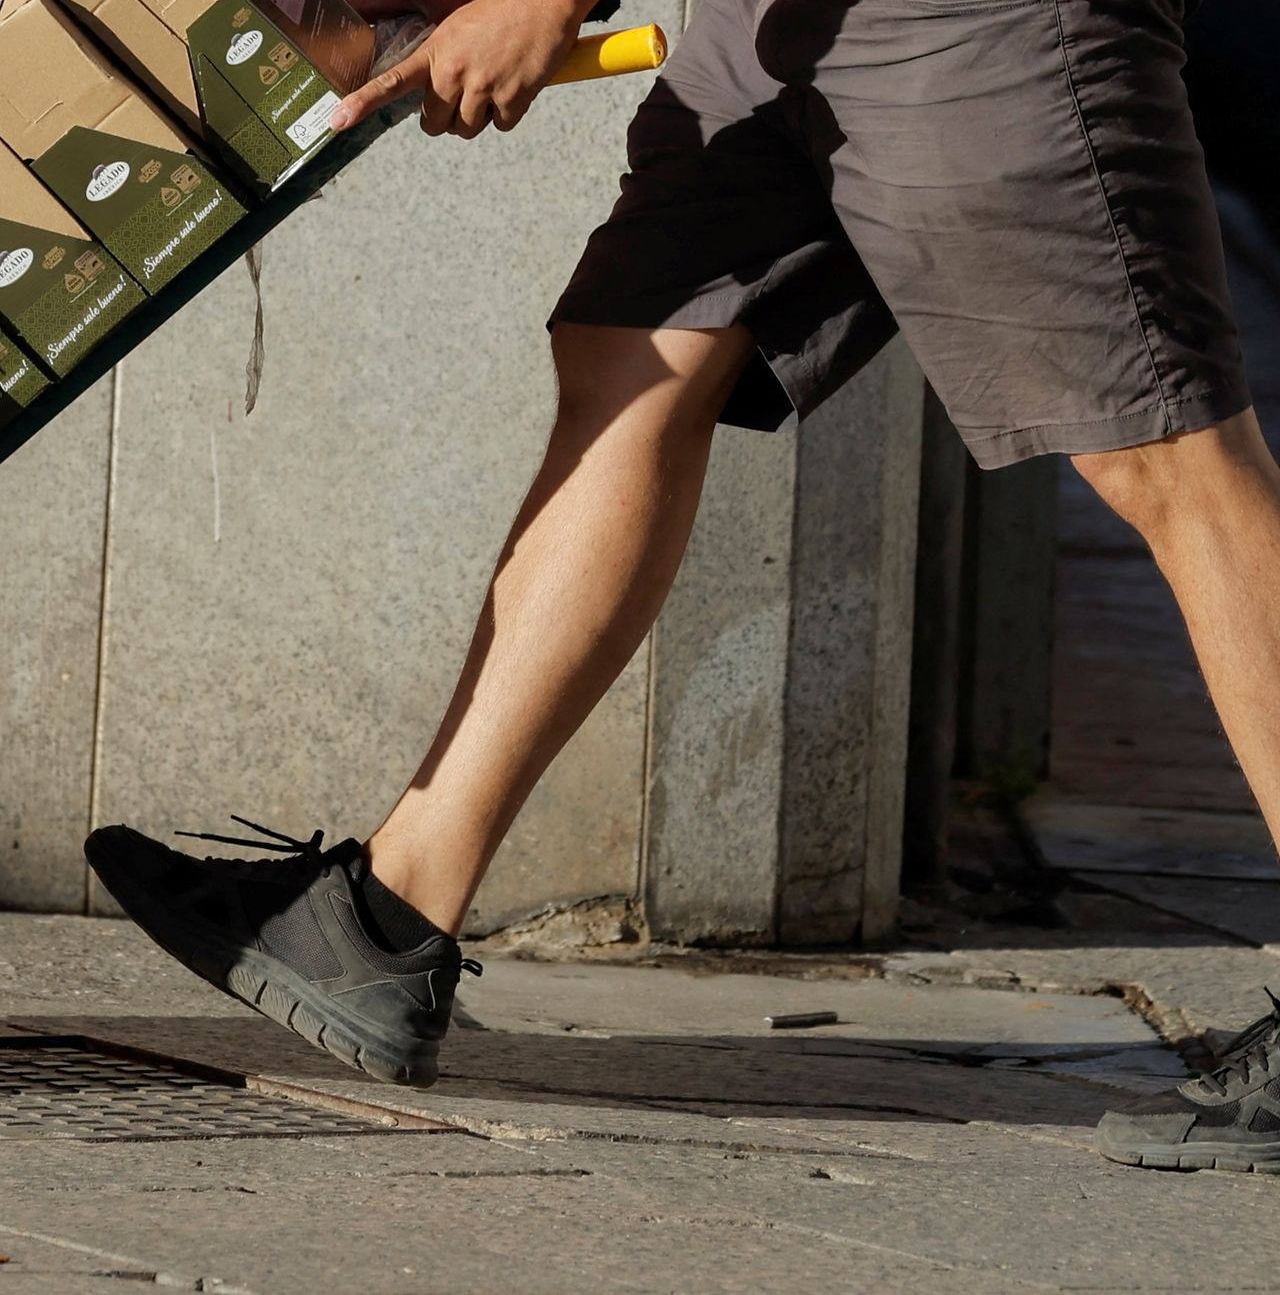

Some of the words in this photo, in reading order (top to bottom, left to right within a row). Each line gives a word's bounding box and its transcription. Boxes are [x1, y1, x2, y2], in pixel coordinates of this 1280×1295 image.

[227, 32, 259, 62] LEGADO
[88, 164, 125, 197] LEGADO
[142, 236, 180, 279] ¡Siempre
[179, 220, 197, 239] sale
[192, 188, 223, 223] bueno!
[46, 323, 84, 365] ¡Siempre
[83, 306, 100, 325] sale
[96, 274, 127, 310] bueno!
[0, 359, 29, 393] bueno!
